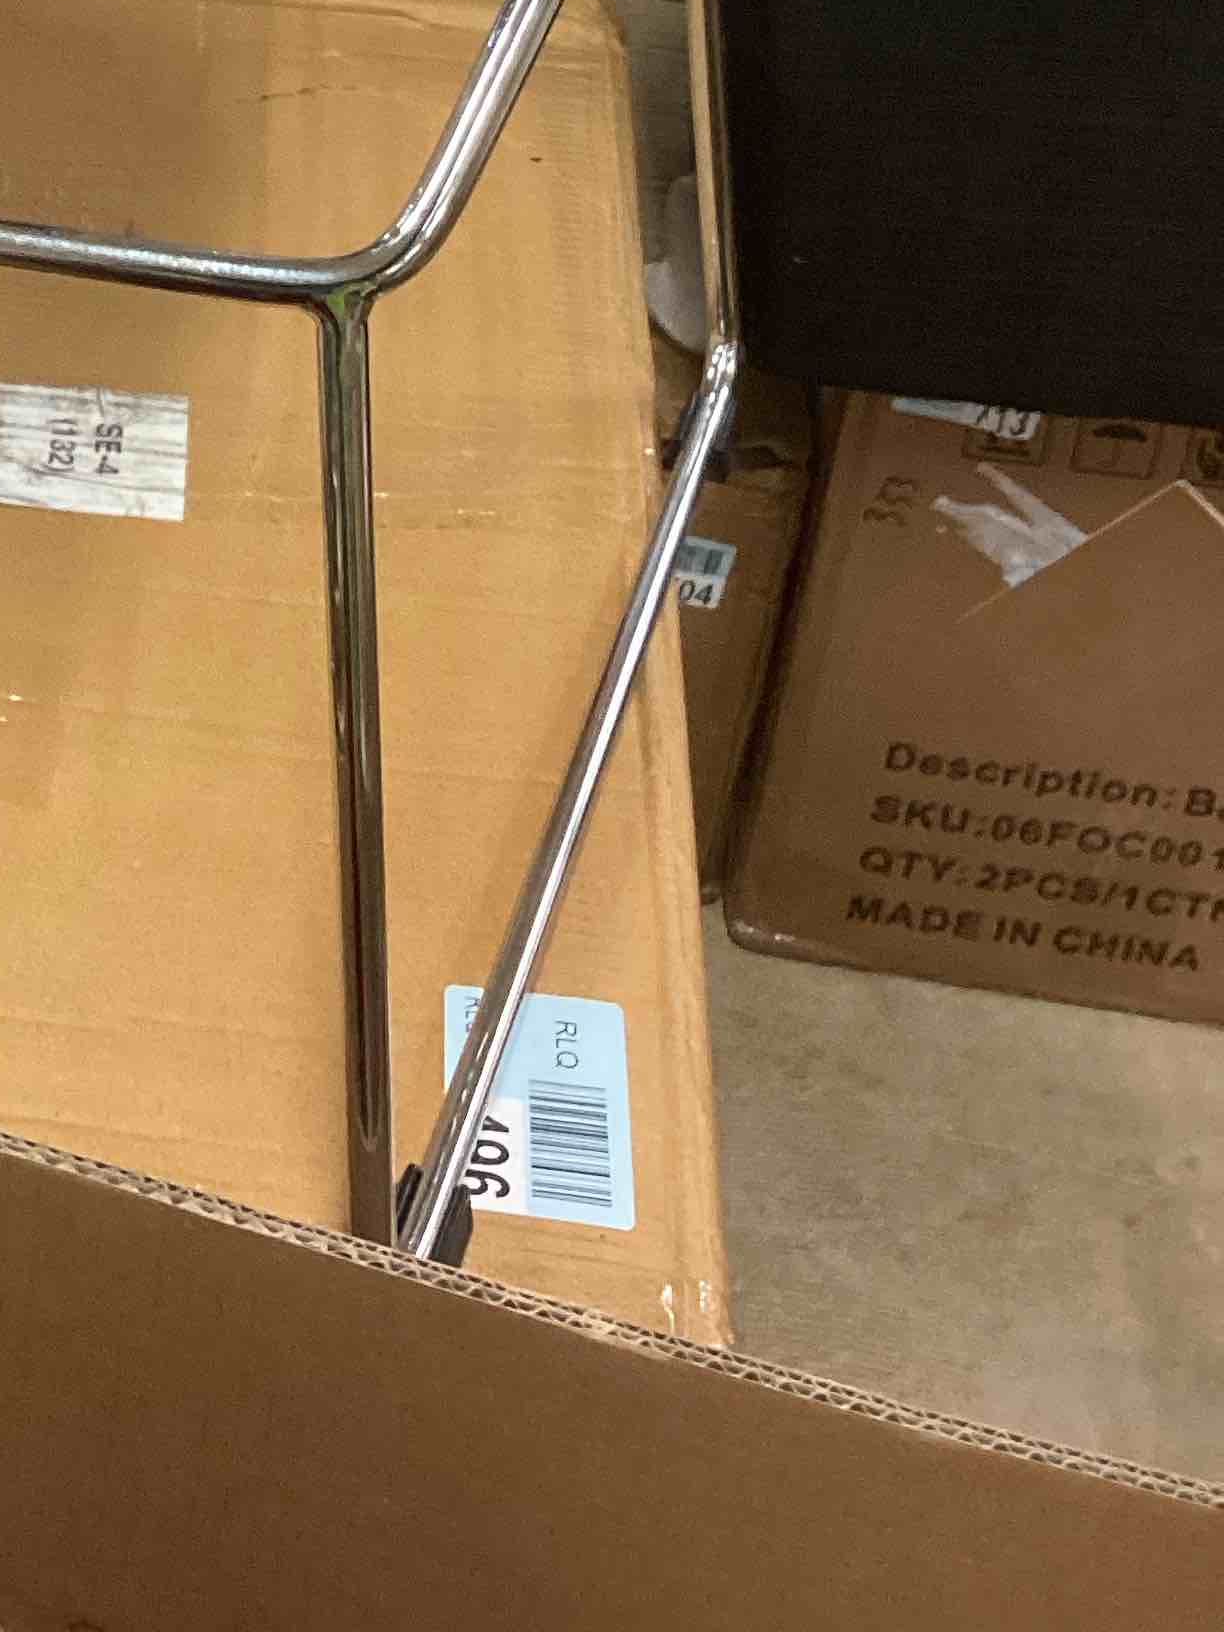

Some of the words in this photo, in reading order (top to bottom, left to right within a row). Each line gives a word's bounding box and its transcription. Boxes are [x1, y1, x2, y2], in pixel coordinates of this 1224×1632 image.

[846, 894, 983, 942] MADE
[992, 917, 1042, 948] IN
[1052, 925, 1200, 972] CHINA
[554, 1019, 580, 1071] RLQ
